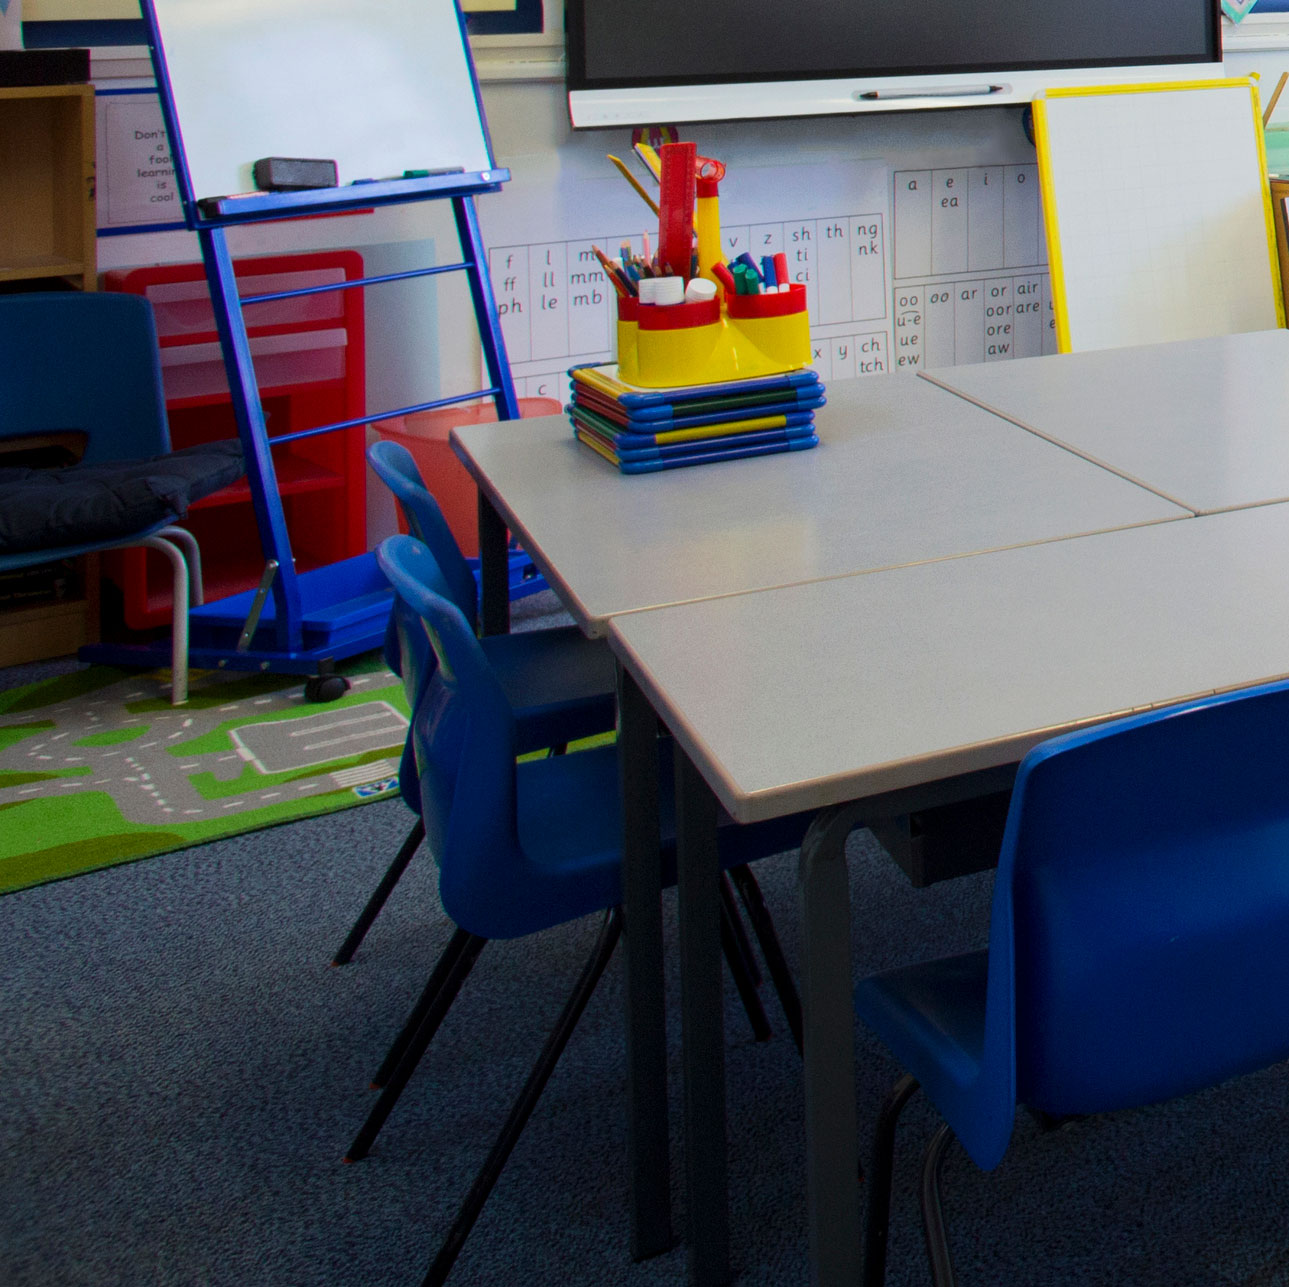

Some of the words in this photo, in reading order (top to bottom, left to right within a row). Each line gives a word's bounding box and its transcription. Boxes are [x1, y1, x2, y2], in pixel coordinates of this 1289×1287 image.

[135, 130, 165, 140] Don't
[156, 144, 164, 152] a
[157, 181, 167, 189] is
[908, 179, 918, 191] a
[946, 177, 954, 188] e
[983, 172, 989, 186] i
[1017, 173, 1026, 184] o
[150, 192, 174, 203] cool
[941, 196, 959, 208] ea
[505, 254, 515, 269] f
[546, 250, 551, 265] l
[579, 250, 597, 262] m
[729, 237, 738, 248] v
[764, 234, 772, 244] z
[792, 227, 811, 242] sh
[826, 224, 843, 239] th
[857, 224, 878, 239] ng
[504, 277, 517, 292] ff
[544, 272, 555, 288] ll
[570, 271, 605, 285] mm
[796, 248, 809, 262] ti
[858, 241, 879, 256] nk
[498, 297, 523, 316] ph
[541, 295, 558, 310] le
[573, 289, 602, 306] mb
[796, 267, 810, 282] ci
[899, 295, 919, 307] oo
[930, 291, 949, 304] oo
[960, 288, 978, 301] ar
[990, 285, 1007, 297] or
[1017, 281, 1038, 295] air
[896, 314, 921, 327] u-e
[986, 304, 1012, 317] oor
[1016, 301, 1040, 313] are
[900, 334, 918, 347] ue
[986, 323, 1011, 336] ore
[538, 384, 547, 395] c
[814, 348, 822, 359] x
[839, 344, 848, 360] y
[861, 337, 881, 354] ch
[860, 357, 884, 373] tch
[897, 353, 920, 366] ew
[987, 342, 1009, 355] aw
